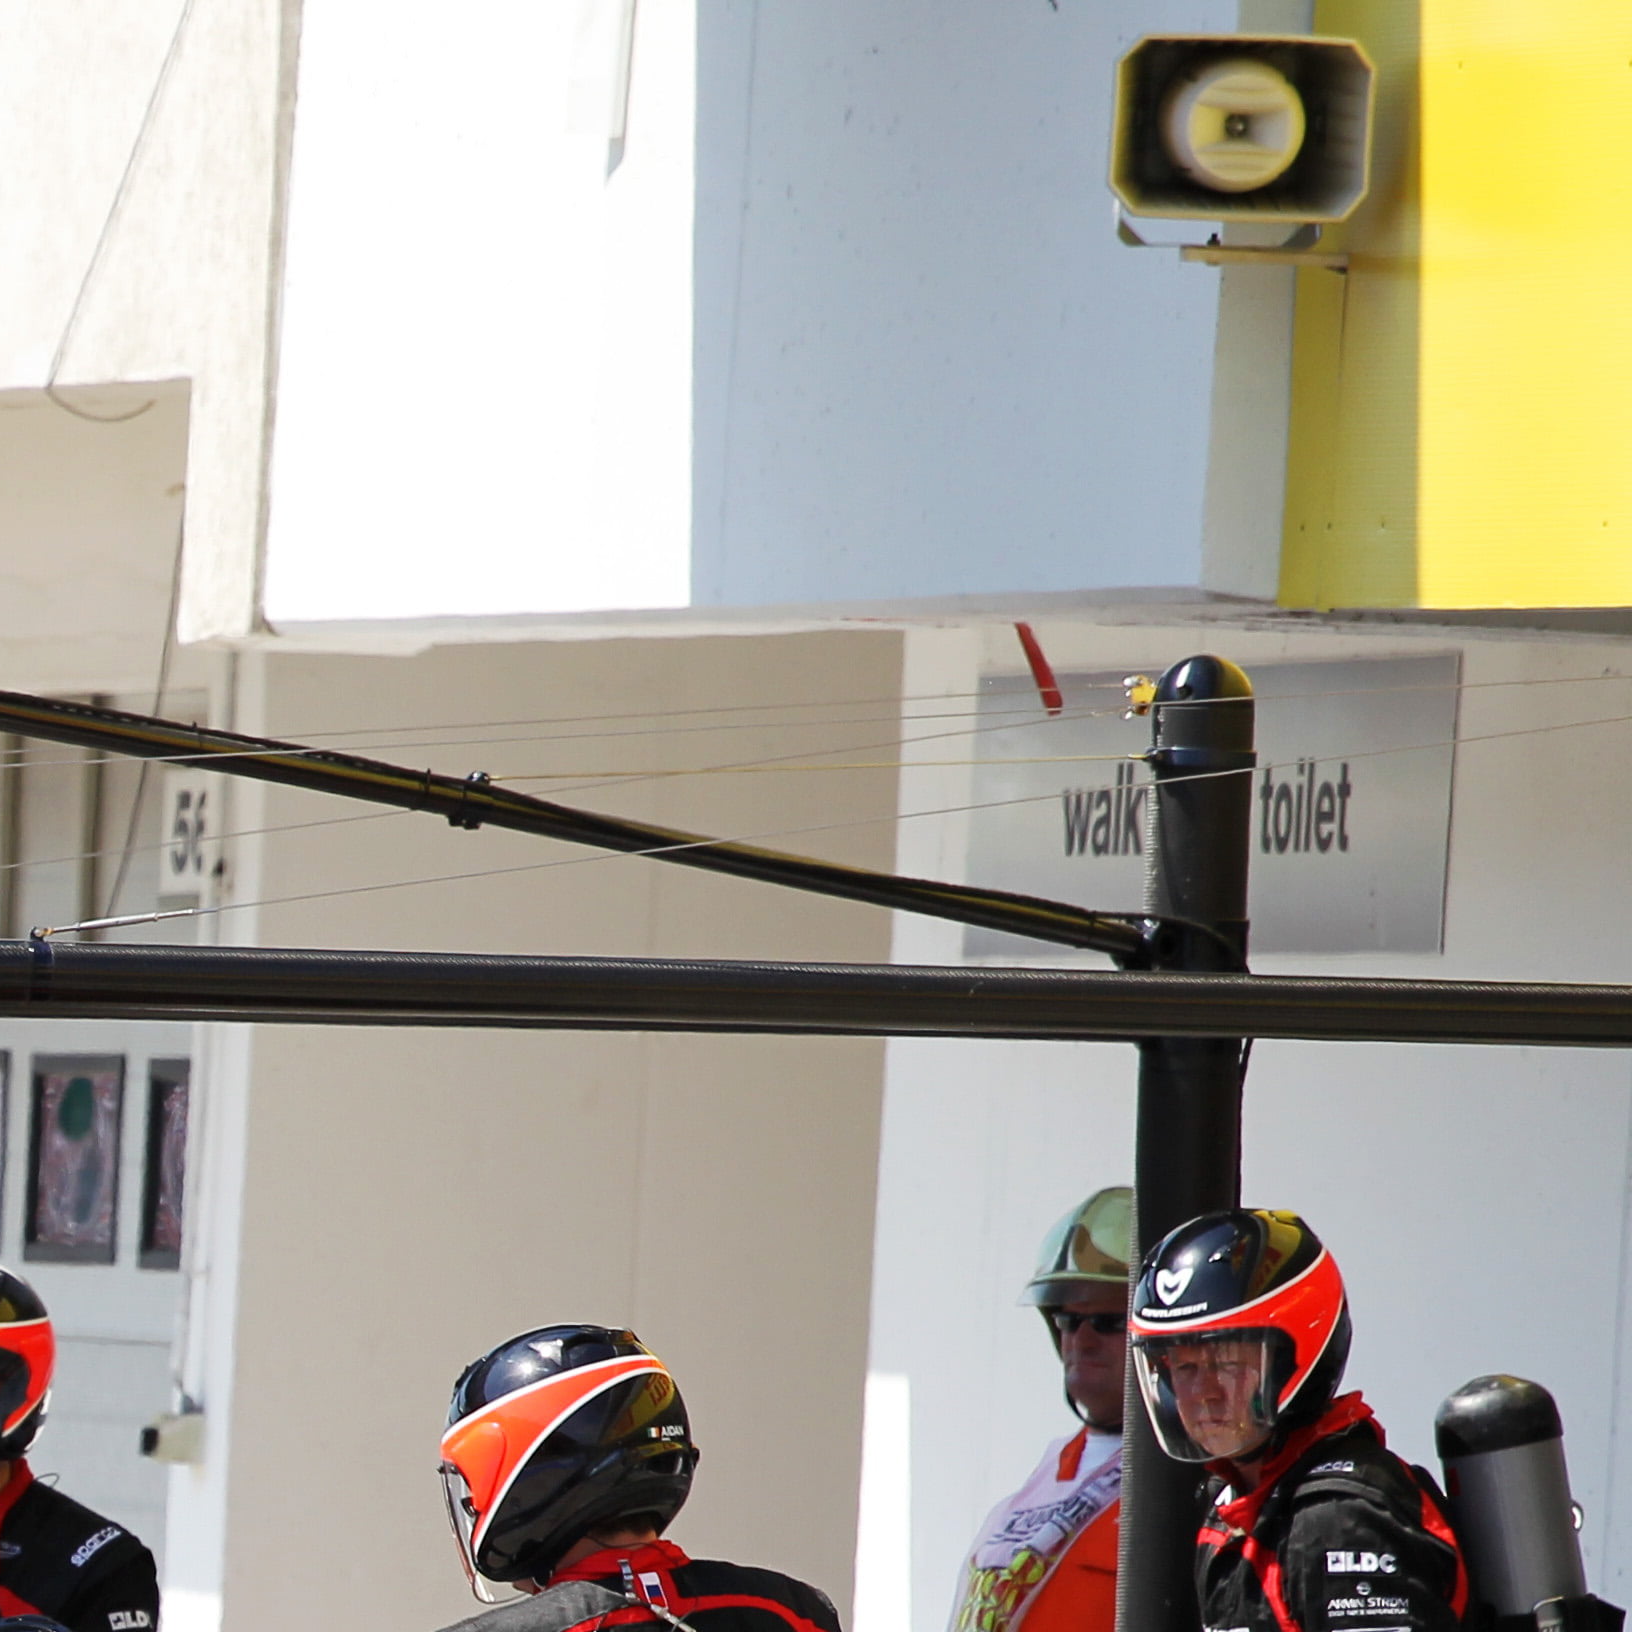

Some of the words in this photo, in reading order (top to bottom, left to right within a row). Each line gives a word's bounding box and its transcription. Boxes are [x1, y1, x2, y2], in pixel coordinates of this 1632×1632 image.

[1062, 761, 1146, 858] walk
[1260, 757, 1351, 855] toilet
[69, 1526, 122, 1568] sparco
[1345, 1551, 1398, 1574] LDC
[124, 1610, 153, 1629] LD
